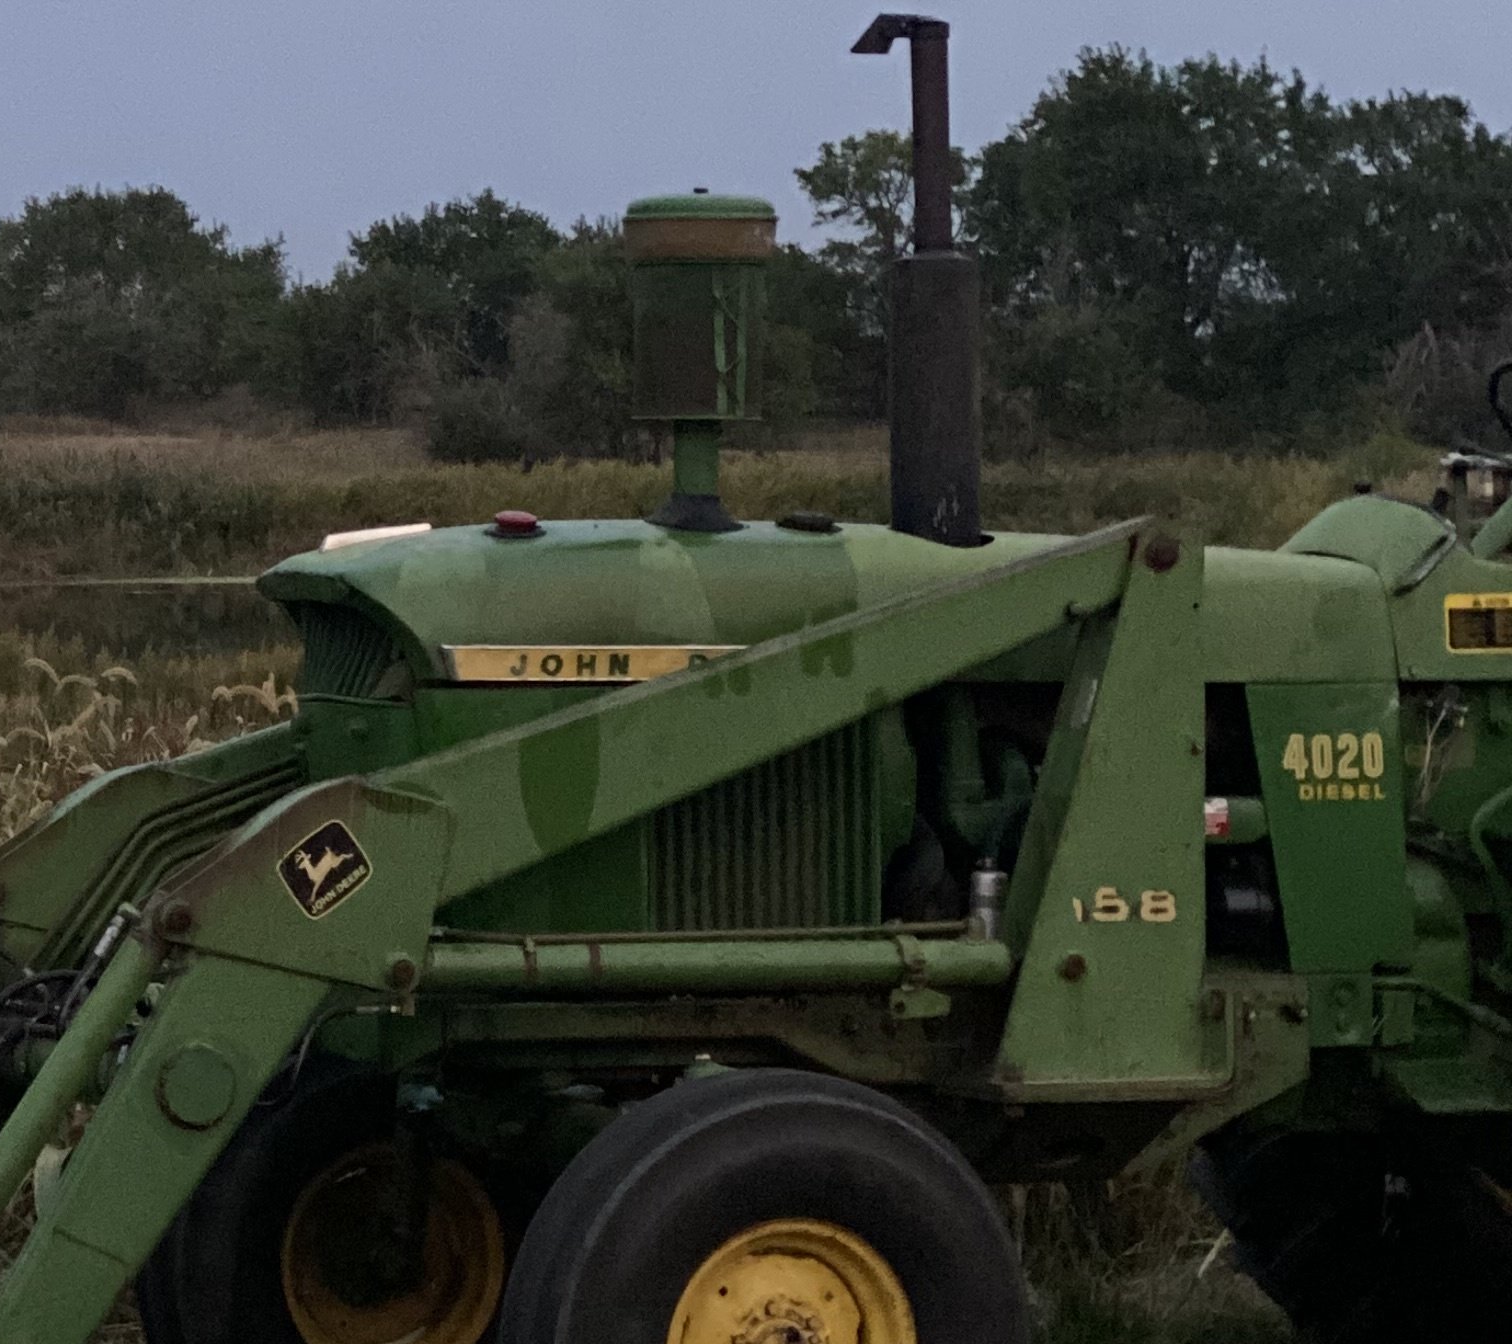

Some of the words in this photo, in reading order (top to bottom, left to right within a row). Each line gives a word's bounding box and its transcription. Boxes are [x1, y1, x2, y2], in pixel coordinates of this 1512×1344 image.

[509, 654, 630, 676] JOHN
[1282, 732, 1384, 779] 4020
[1299, 783, 1386, 800] DIESEL
[311, 889, 336, 914] JOHN
[336, 864, 367, 894] DEERE
